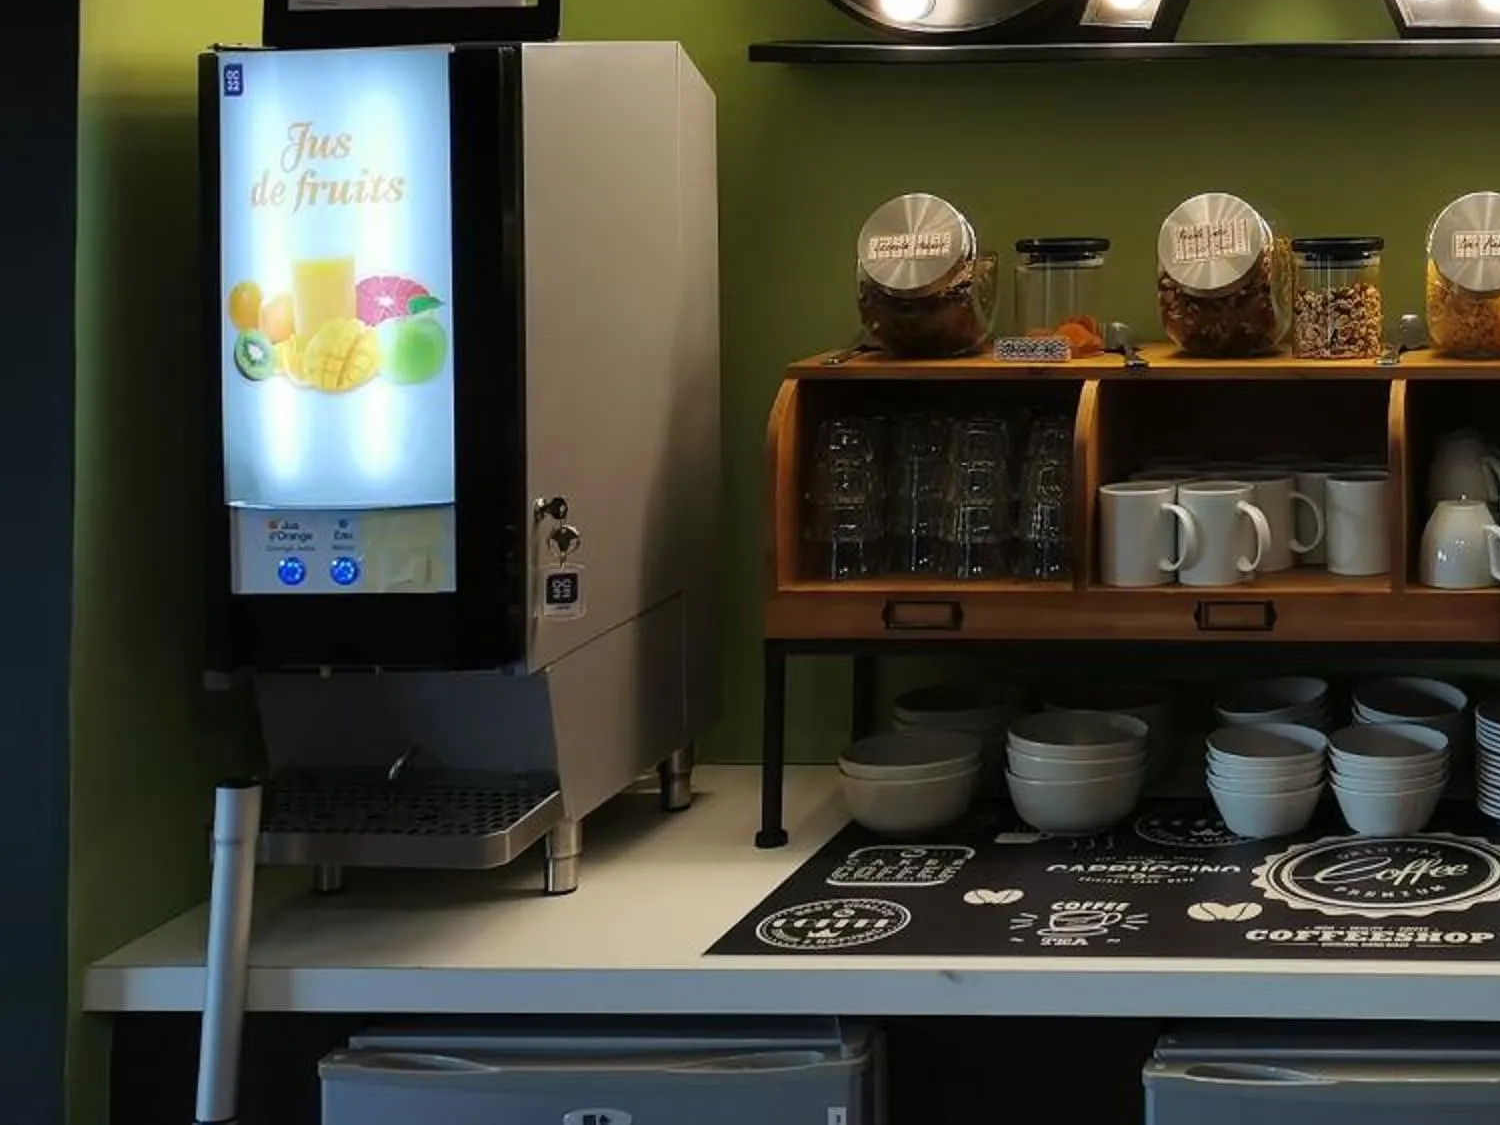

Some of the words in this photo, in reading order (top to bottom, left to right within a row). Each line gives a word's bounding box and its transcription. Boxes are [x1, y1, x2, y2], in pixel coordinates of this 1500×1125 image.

[280, 121, 353, 173] Jus
[251, 168, 287, 206] de
[293, 168, 406, 213] fruits
[1313, 855, 1470, 886] Coffee
[1050, 901, 1132, 912] COFFEE
[1245, 928, 1495, 944] COFFEESHOP
